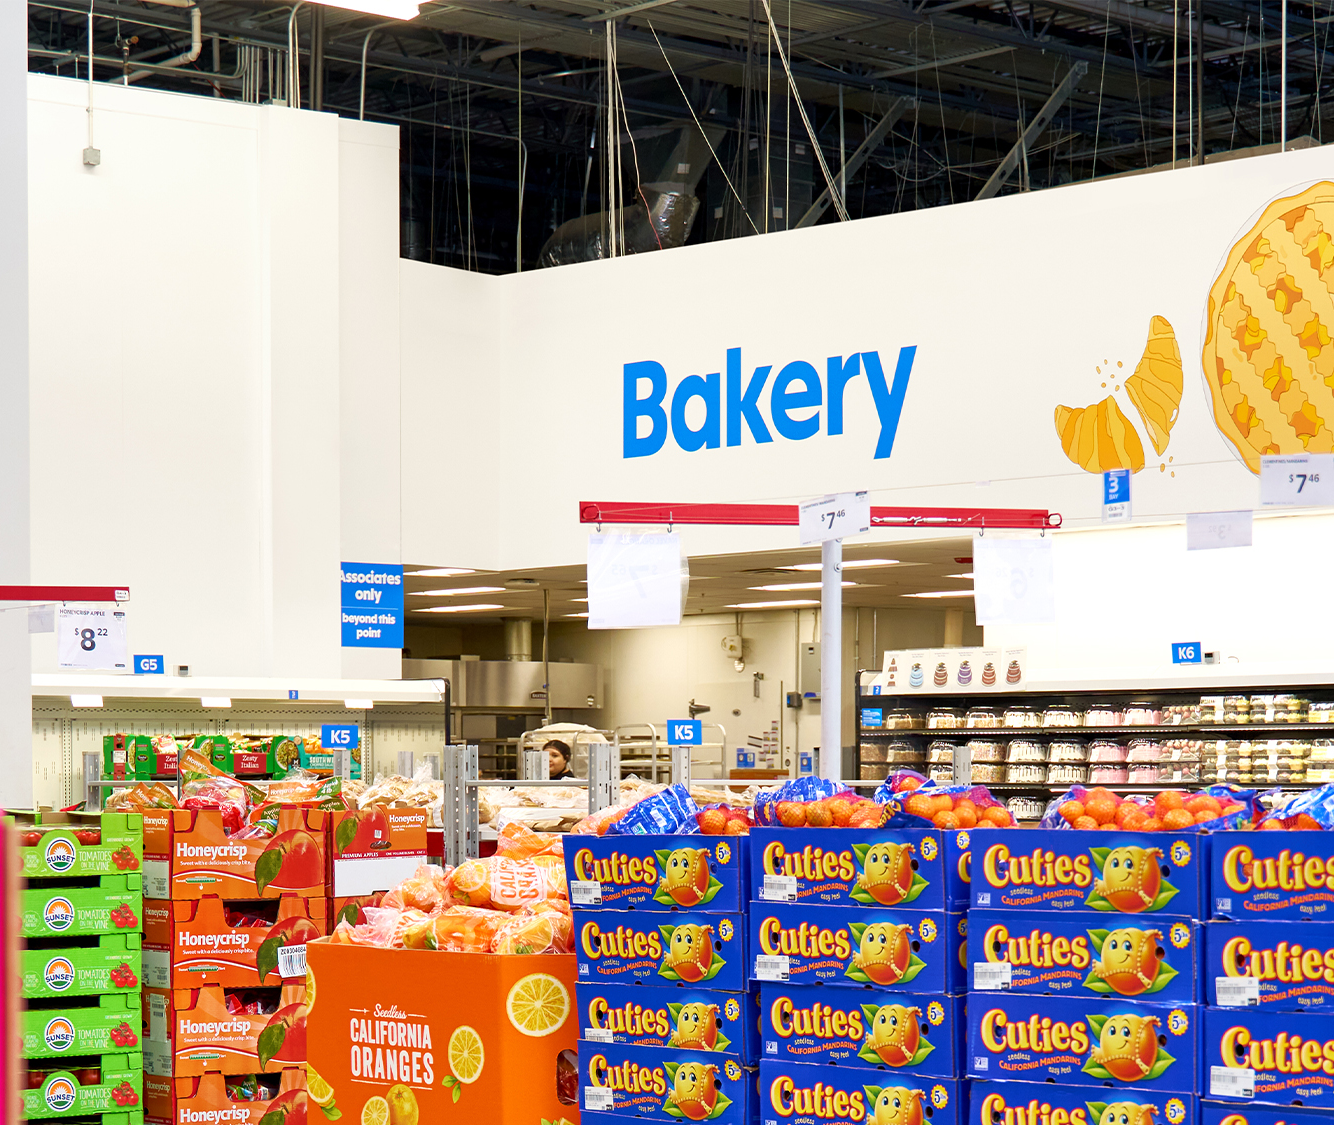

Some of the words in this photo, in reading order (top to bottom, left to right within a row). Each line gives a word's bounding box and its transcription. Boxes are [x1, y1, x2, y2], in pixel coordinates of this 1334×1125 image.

[623, 345, 917, 460] Bakery
[1108, 476, 1119, 494] 3
[340, 569, 401, 585] Associates
[355, 588, 382, 604] only
[342, 613, 378, 625] beyond
[378, 613, 396, 625] this
[356, 627, 381, 640] point
[1178, 646, 1195, 660] K6
[140, 658, 158, 671] G5
[330, 730, 351, 744] K5
[674, 725, 694, 740] K5
[240, 761, 260, 769] Italian
[242, 755, 258, 764] Zesty
[389, 813, 425, 824] Honeycrisp
[45, 854, 76, 864] SUNSET
[79, 850, 112, 863] TOMATOES
[176, 842, 248, 861] Honeycrisp
[574, 848, 657, 885] Cuties
[763, 841, 855, 881] Cuties
[983, 843, 1092, 889] Cuties
[1001, 895, 1042, 906] CALIFORNIA
[1042, 889, 1084, 901] MANDARINS
[44, 913, 74, 924] SUNSET
[77, 909, 110, 921] TOMATOES
[179, 930, 250, 949] Honeycrisp
[581, 921, 662, 961] Cuties
[759, 916, 851, 960] Cuties
[983, 924, 1090, 971] Cuties
[45, 973, 75, 984] SUNSET
[77, 968, 110, 981] TOMATOES
[373, 1003, 407, 1020] Seedless
[589, 996, 669, 1037] Cuties
[770, 996, 865, 1042] Cuties
[78, 1028, 110, 1041] TOMATOES
[180, 1017, 251, 1036] Honeycrisp
[350, 1017, 432, 1050] CALIFORNIA
[980, 1008, 1089, 1055] Cuties
[45, 1032, 75, 1043] SUNSET
[351, 1044, 434, 1085] ORANGES
[587, 1054, 667, 1094] Cuties
[46, 1093, 76, 1104] SUNSET
[79, 1088, 111, 1101] TOMATOES
[770, 1075, 866, 1121] Cuties
[180, 1105, 250, 1125] Honeycrisp
